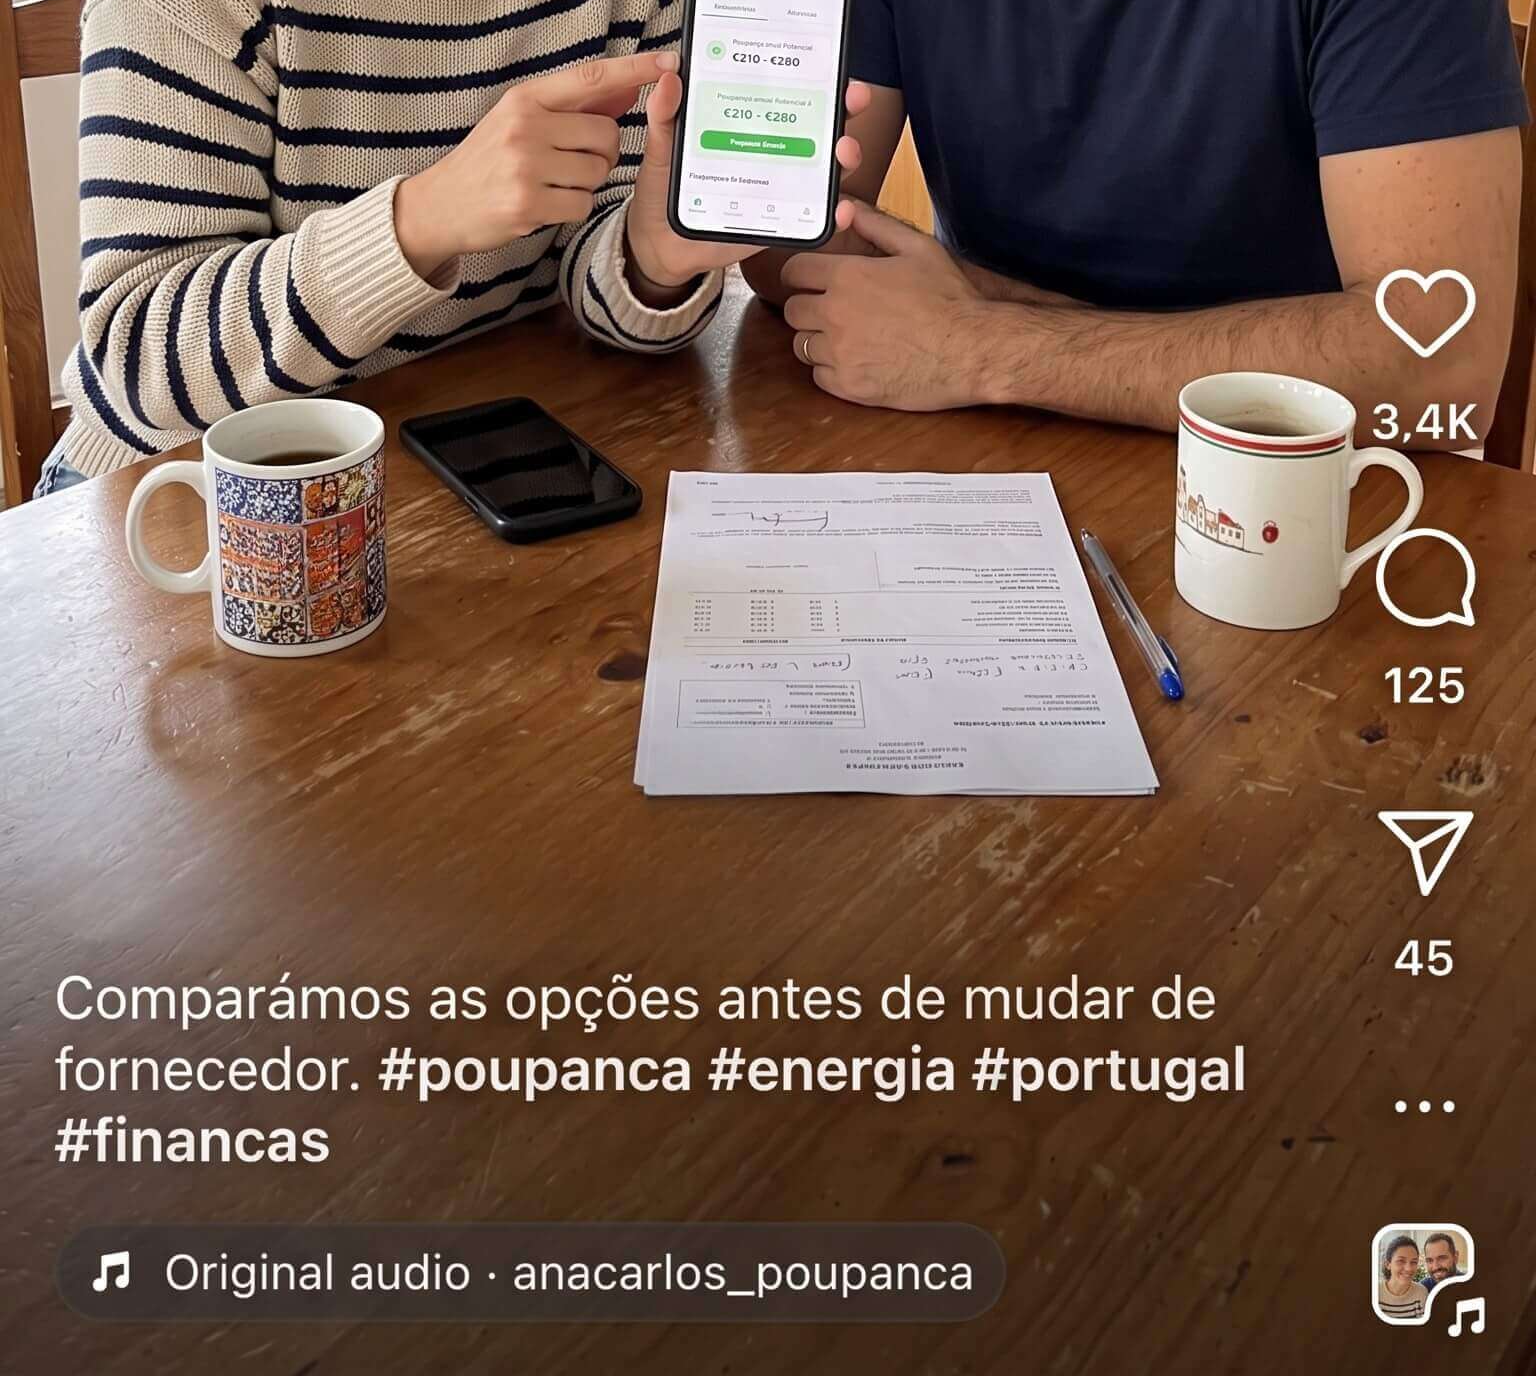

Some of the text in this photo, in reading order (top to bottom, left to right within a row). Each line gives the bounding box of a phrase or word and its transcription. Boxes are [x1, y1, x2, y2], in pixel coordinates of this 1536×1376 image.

[770, 56, 800, 67] €280
[724, 108, 753, 120] €210
[765, 111, 797, 124] €280
